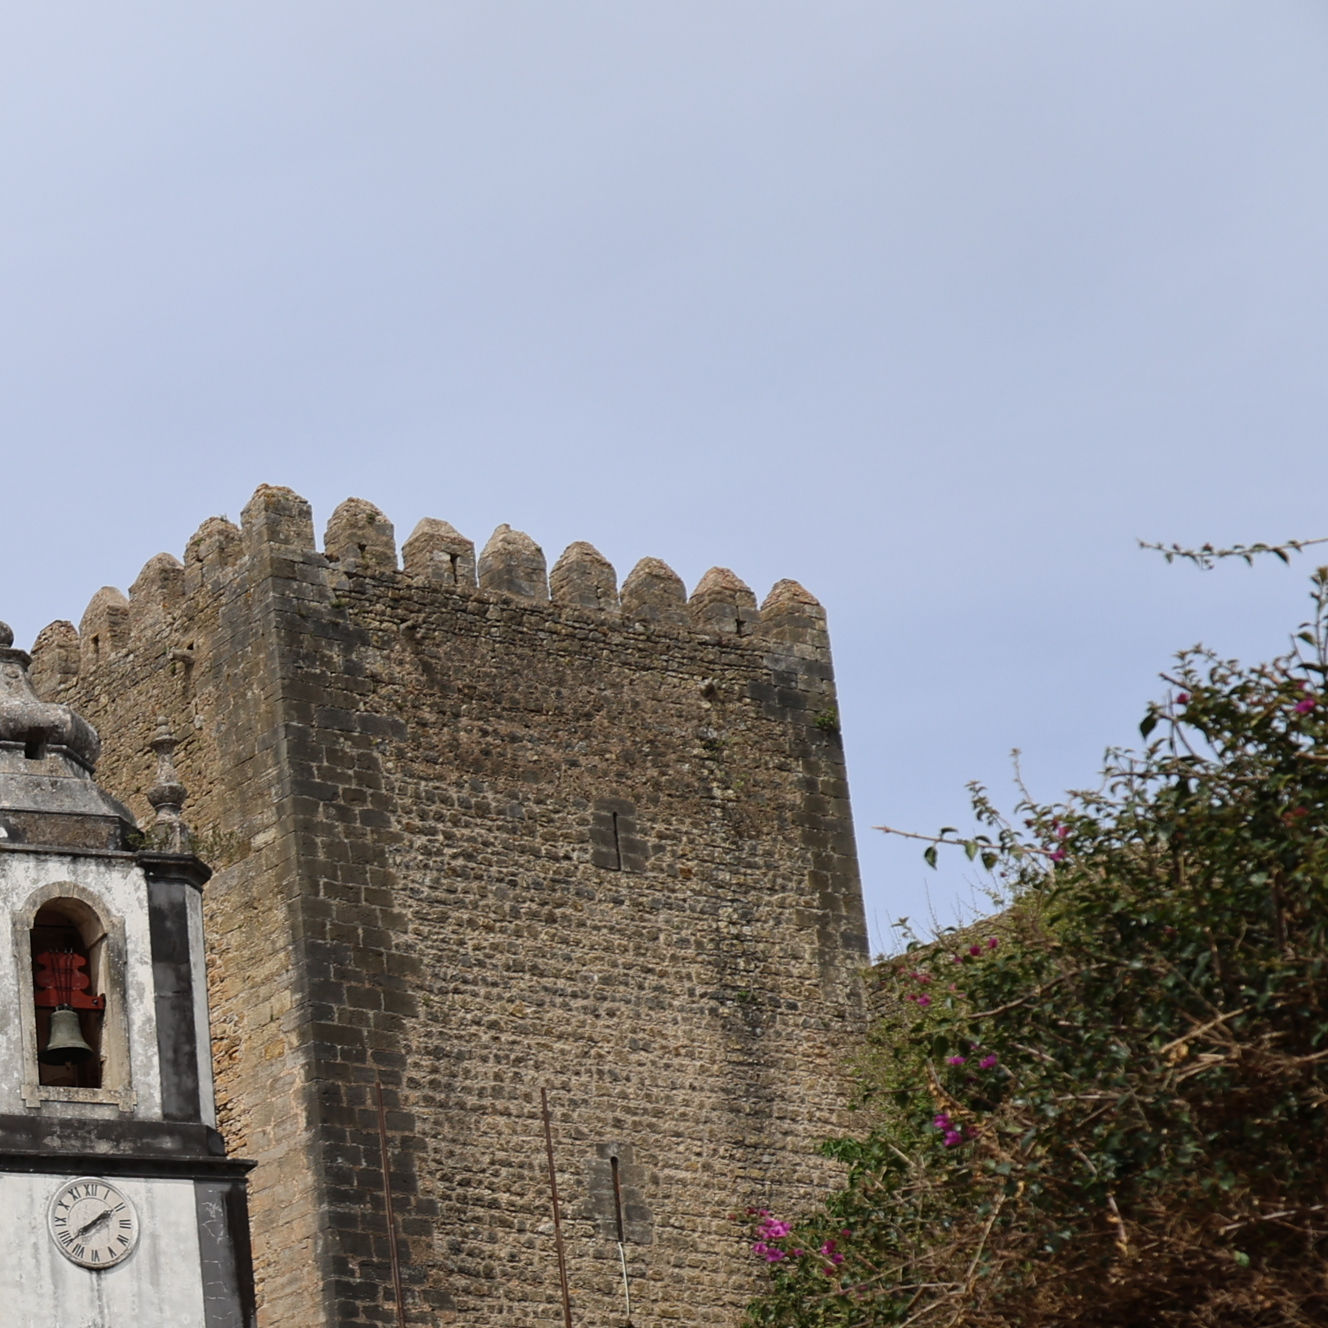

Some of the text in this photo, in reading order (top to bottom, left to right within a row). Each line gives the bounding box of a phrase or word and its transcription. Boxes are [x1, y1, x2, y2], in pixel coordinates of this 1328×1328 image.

[68, 1187, 81, 1201] XI
[84, 1184, 98, 1197] XII
[57, 1200, 70, 1210] X
[114, 1202, 126, 1212] II
[55, 1217, 66, 1226] IX
[120, 1219, 131, 1229] III
[117, 1234, 129, 1246] IV
[72, 1243, 85, 1258] VII
[91, 1250, 100, 1262] VI
